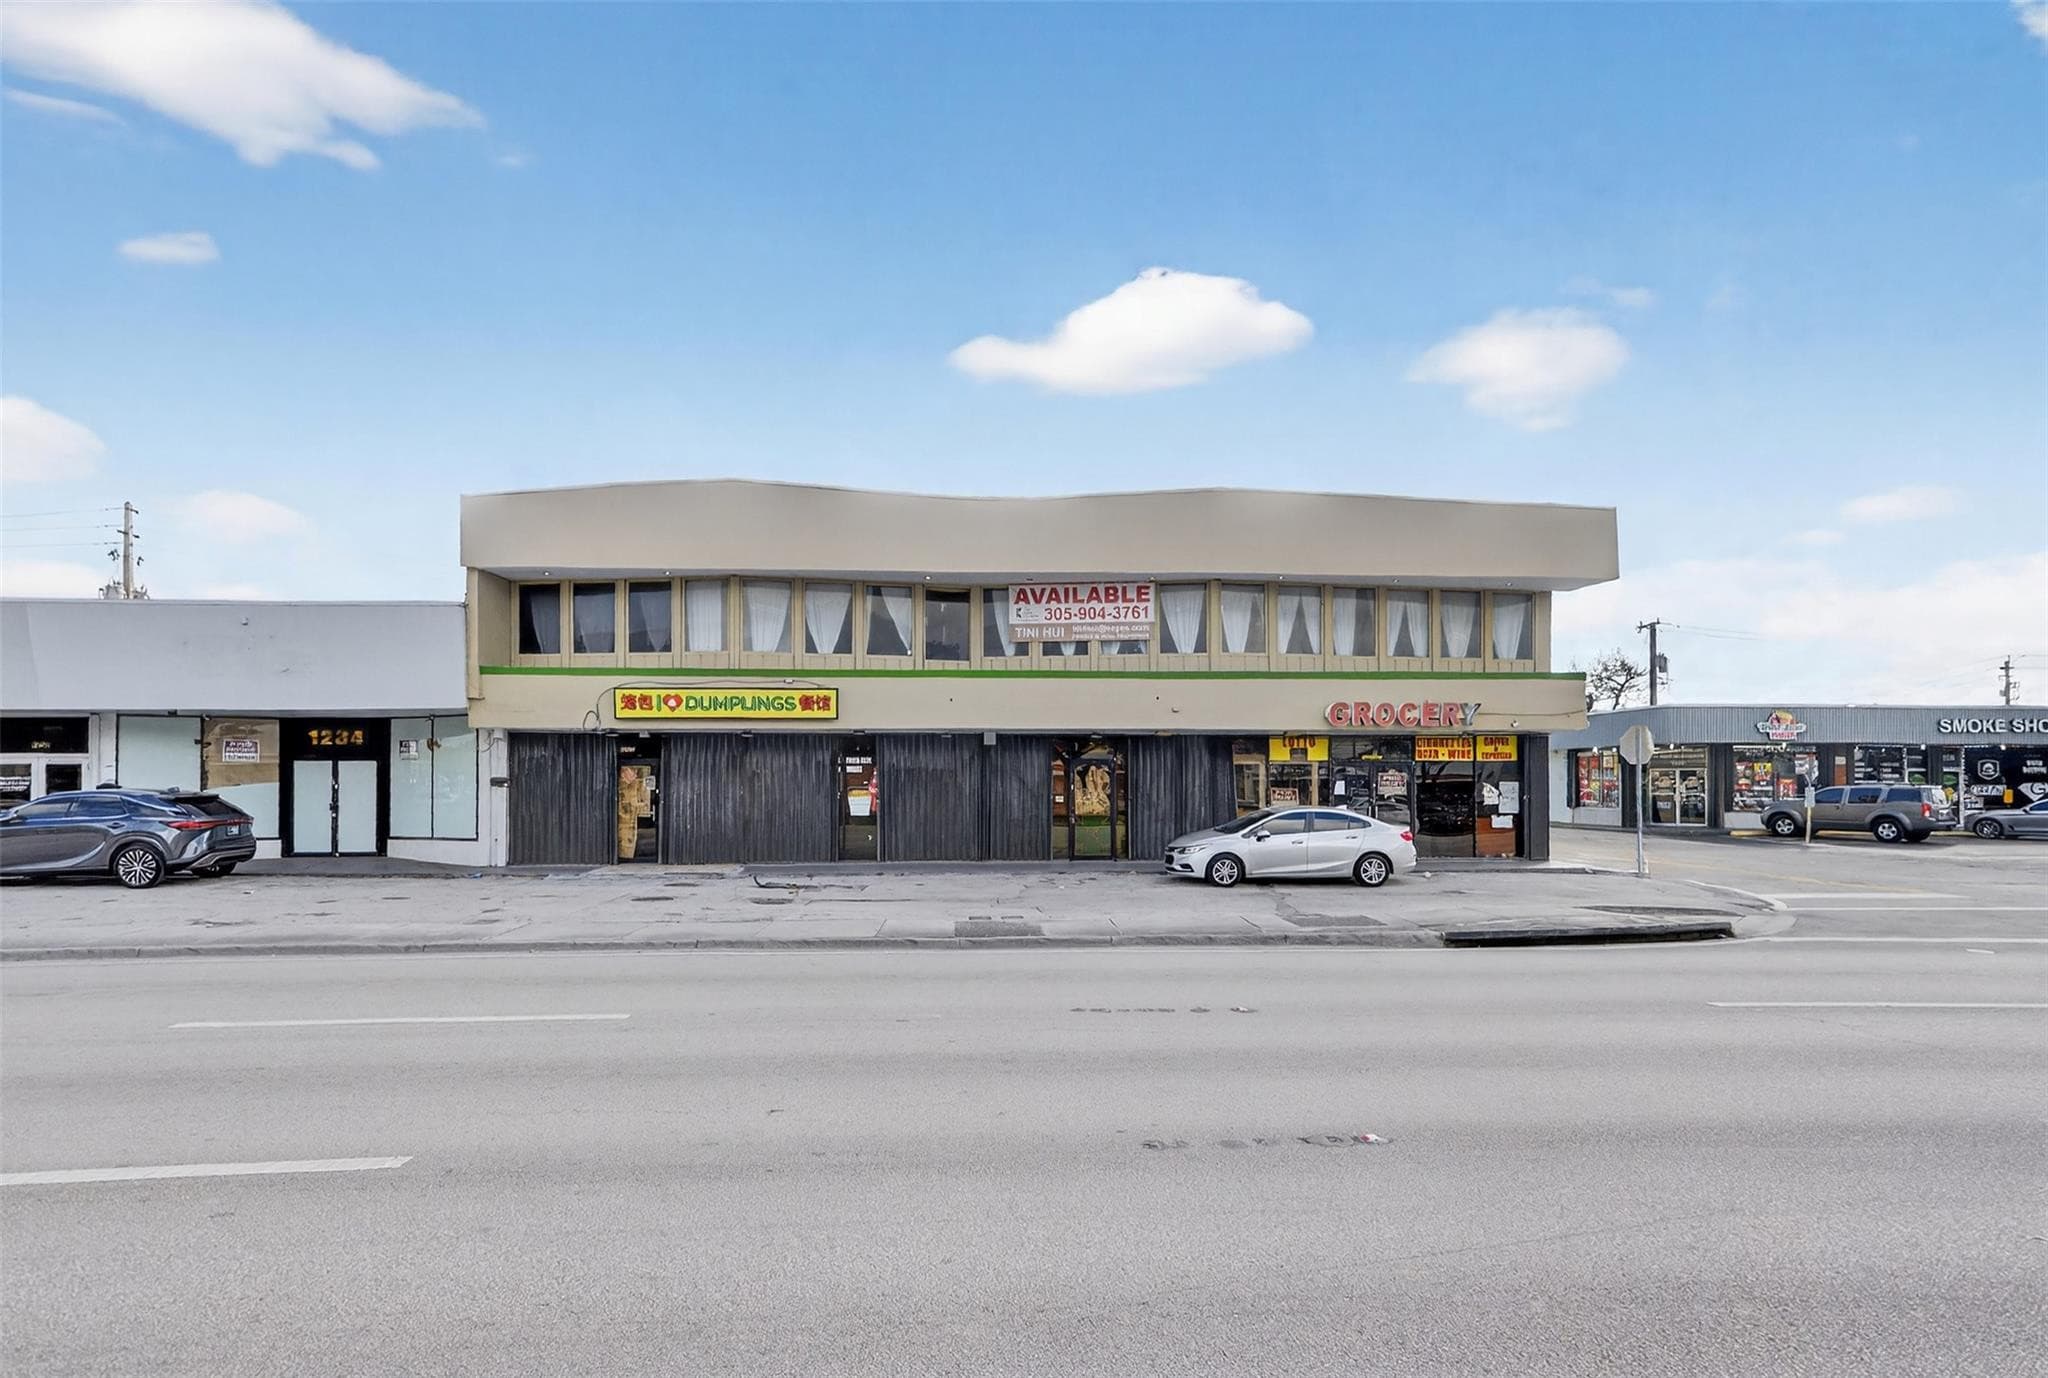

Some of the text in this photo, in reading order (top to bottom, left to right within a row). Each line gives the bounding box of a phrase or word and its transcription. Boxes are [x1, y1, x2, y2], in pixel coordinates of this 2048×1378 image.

[1013, 585, 1151, 604] AVAILABLE
[1044, 605, 1149, 621] 305-904-3761
[1015, 627, 1039, 638] TINI
[1042, 627, 1065, 637] HUI
[656, 694, 798, 712] I DUMPLINGS
[1325, 701, 1482, 728] GROCERY
[1939, 718, 2008, 734] SMOKE
[308, 729, 364, 745] 1234
[1447, 749, 1472, 760] WINE
